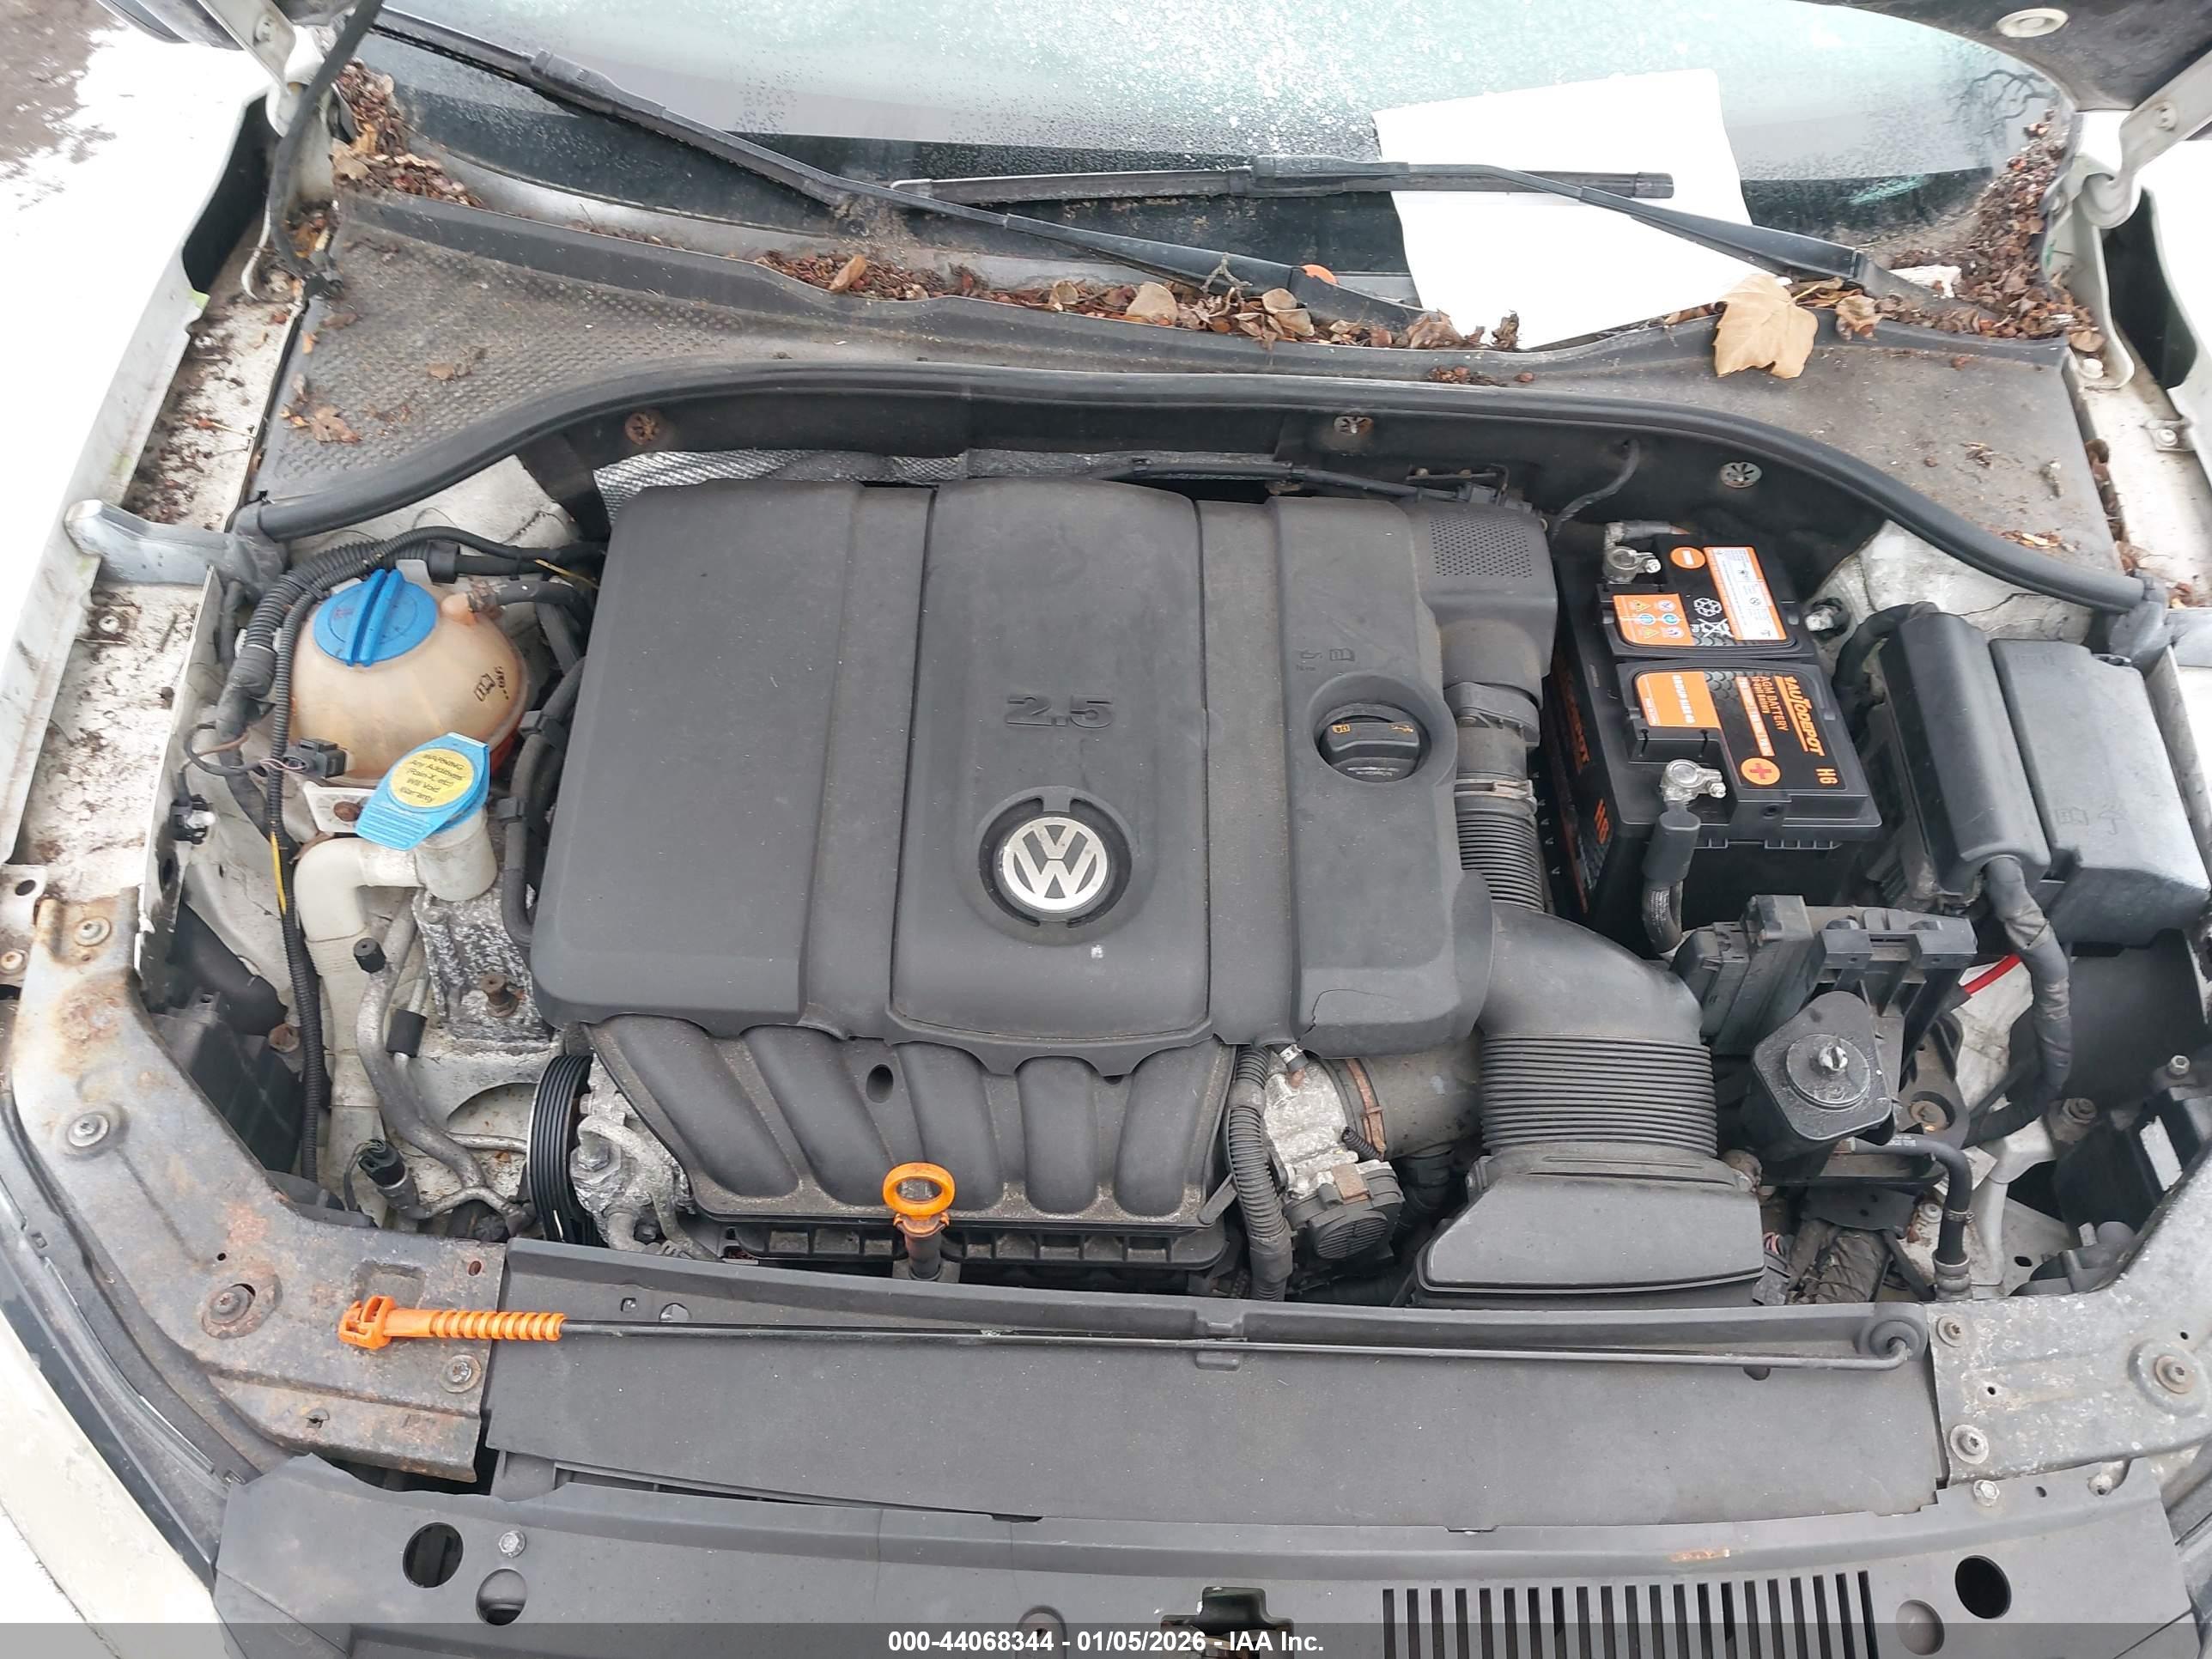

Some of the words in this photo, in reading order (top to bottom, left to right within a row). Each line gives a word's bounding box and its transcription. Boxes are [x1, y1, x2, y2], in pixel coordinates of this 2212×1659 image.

[1760, 676, 1776, 694] AGM
[1005, 694, 1115, 728] 2.5
[1765, 694, 1789, 731] BATTERY
[1815, 769, 1838, 784] H6
[1002, 817, 1109, 913] VW
